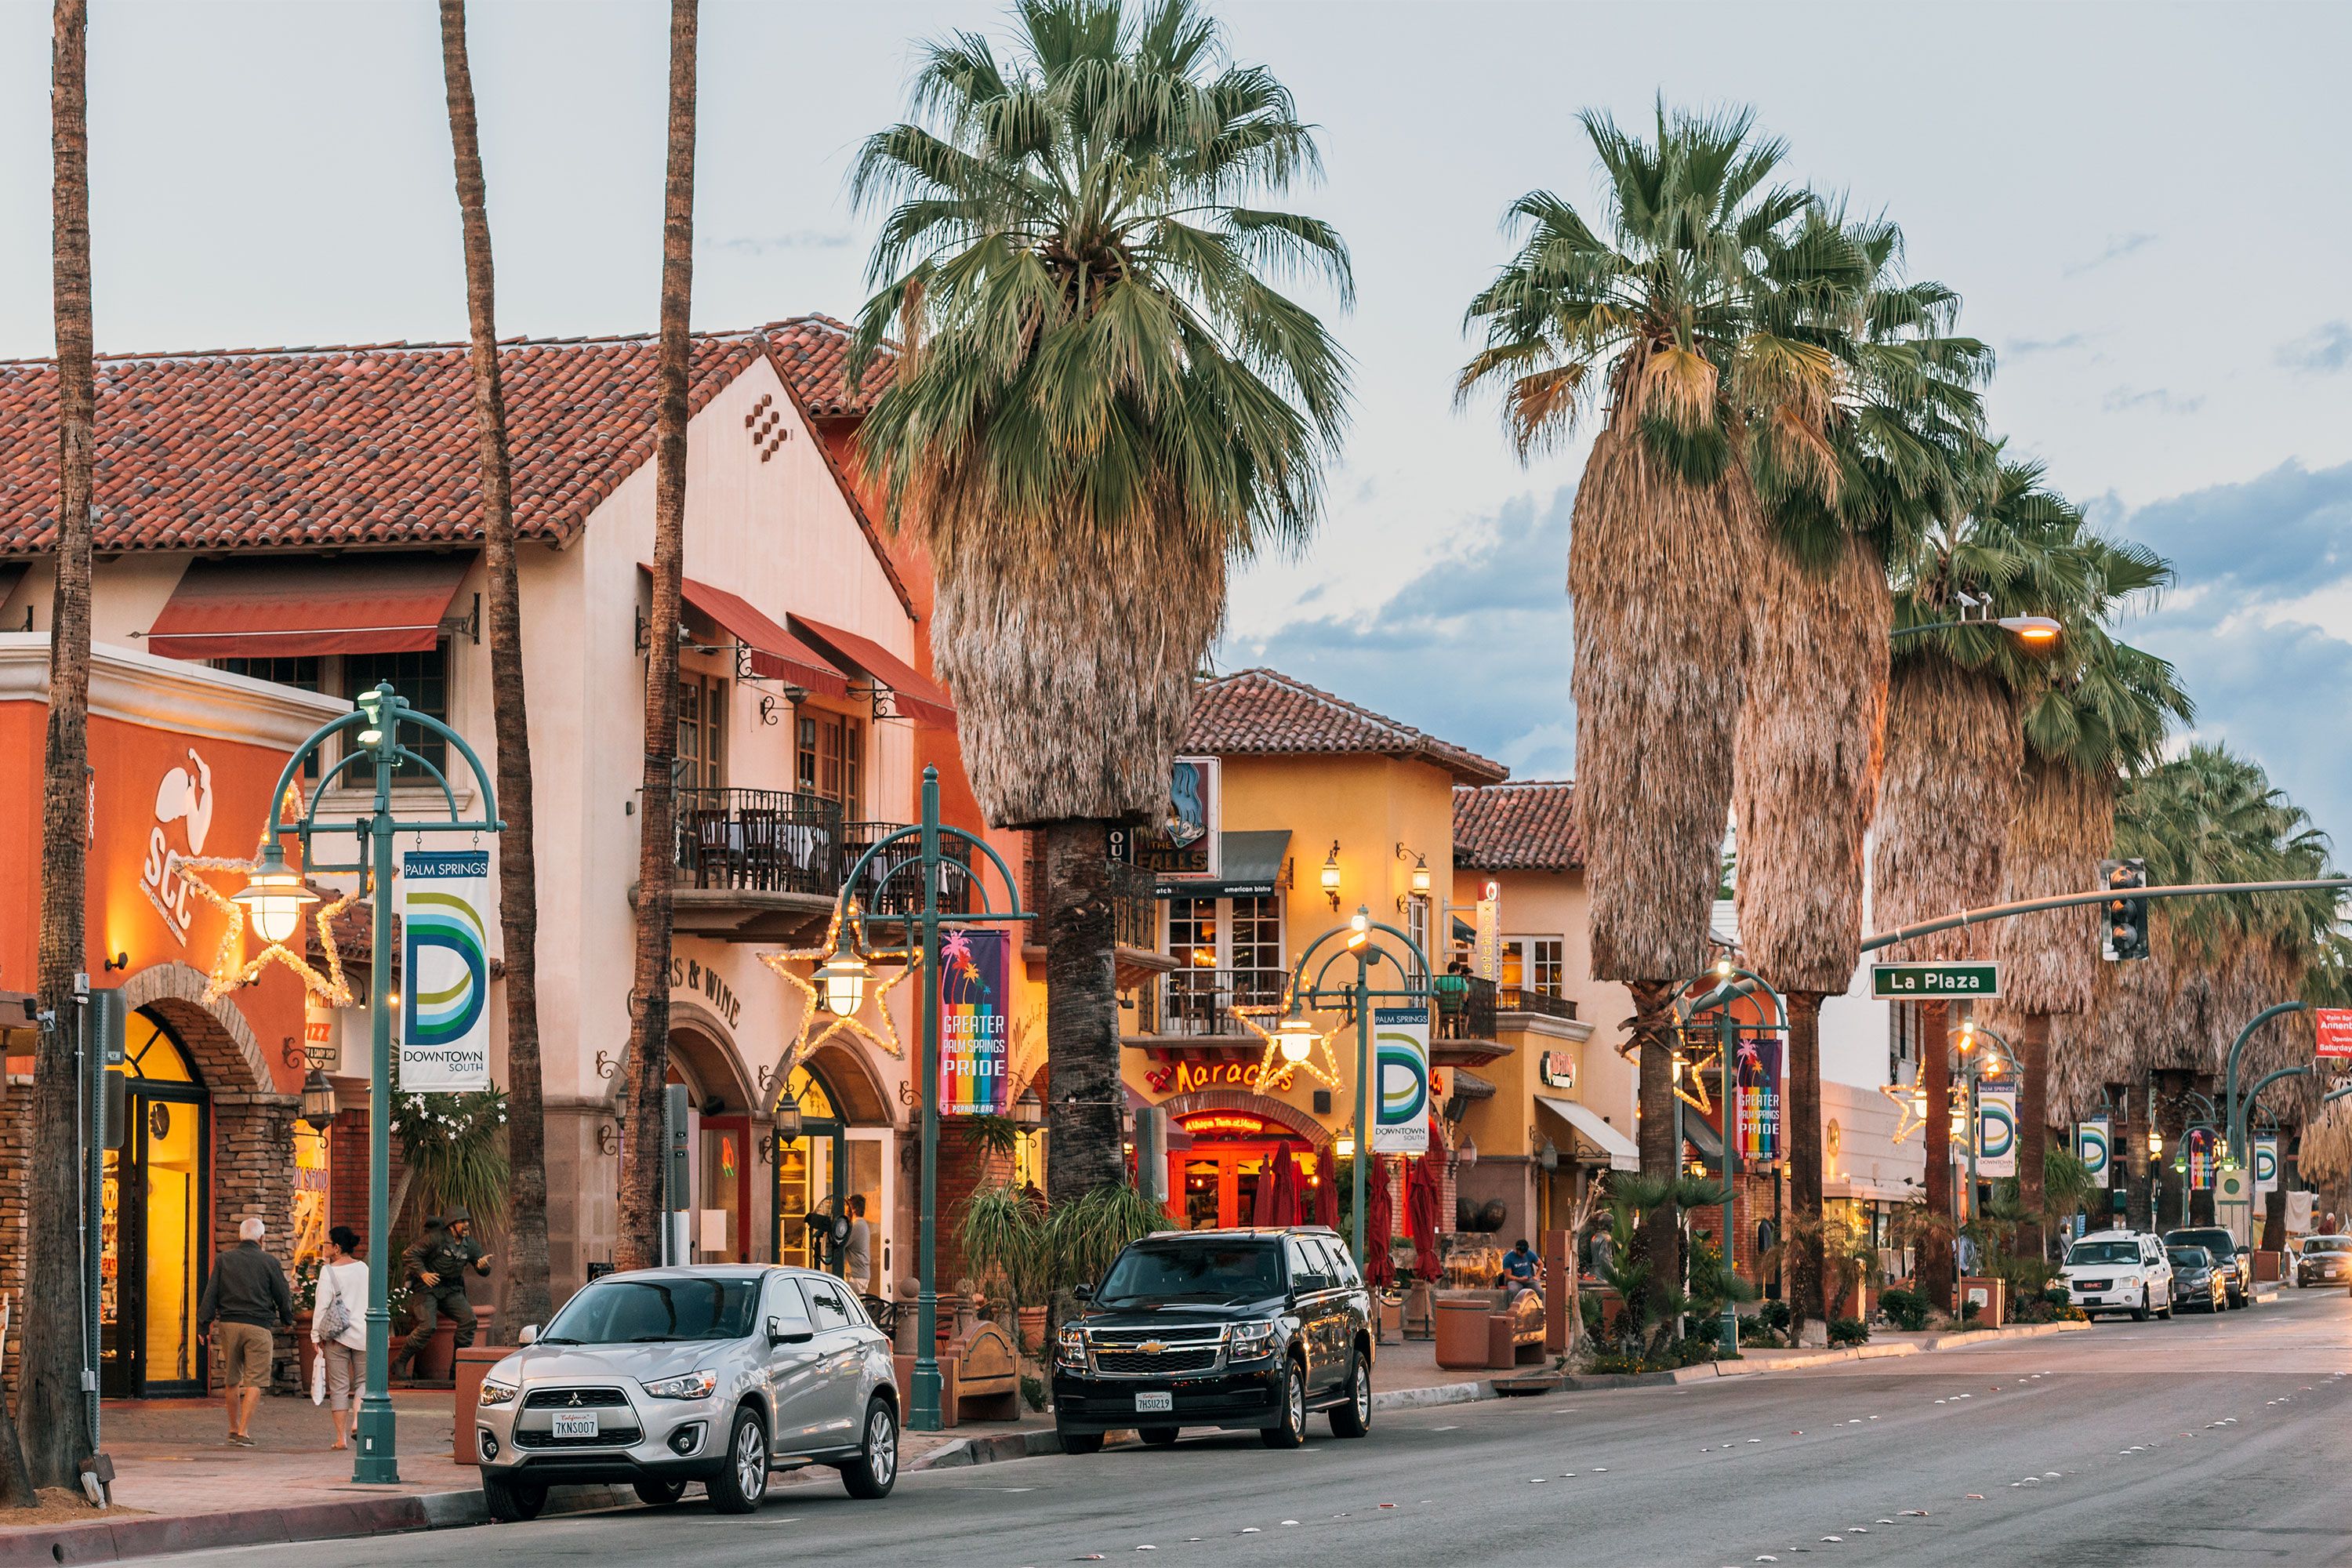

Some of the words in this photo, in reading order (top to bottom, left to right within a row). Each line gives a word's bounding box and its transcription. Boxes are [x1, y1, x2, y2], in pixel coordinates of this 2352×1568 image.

[1151, 840, 1173, 850] THE
[1137, 851, 1208, 871] FALLS
[405, 864, 435, 876] PALM
[438, 862, 487, 875] SPRINGS
[144, 826, 192, 930] SCC
[1224, 885, 1253, 894] american
[1891, 973, 1915, 989] La
[1925, 973, 1980, 989] Plaza
[706, 966, 741, 1030] WINE
[943, 1015, 1004, 1033] GREATER
[1396, 1014, 1428, 1023] SPRINGS
[943, 1039, 966, 1053] PALM
[967, 1039, 1005, 1053] SPRINGS
[404, 1051, 483, 1062] DOWNTOWN
[448, 1063, 483, 1072] SOUTH
[943, 1059, 1005, 1076] PRIDE
[1177, 1060, 1294, 1093] Maracas
[1739, 1094, 1780, 1107] GREATER
[1739, 1109, 1753, 1120] PALM
[1755, 1109, 1780, 1120] SPRINGS
[1185, 1123, 1192, 1131] A
[1739, 1123, 1780, 1134] PRIDE
[304, 1167, 328, 1192] SHOP
[1138, 1399, 1170, 1409] 7HSU219
[555, 1421, 595, 1434] 7KNS007
